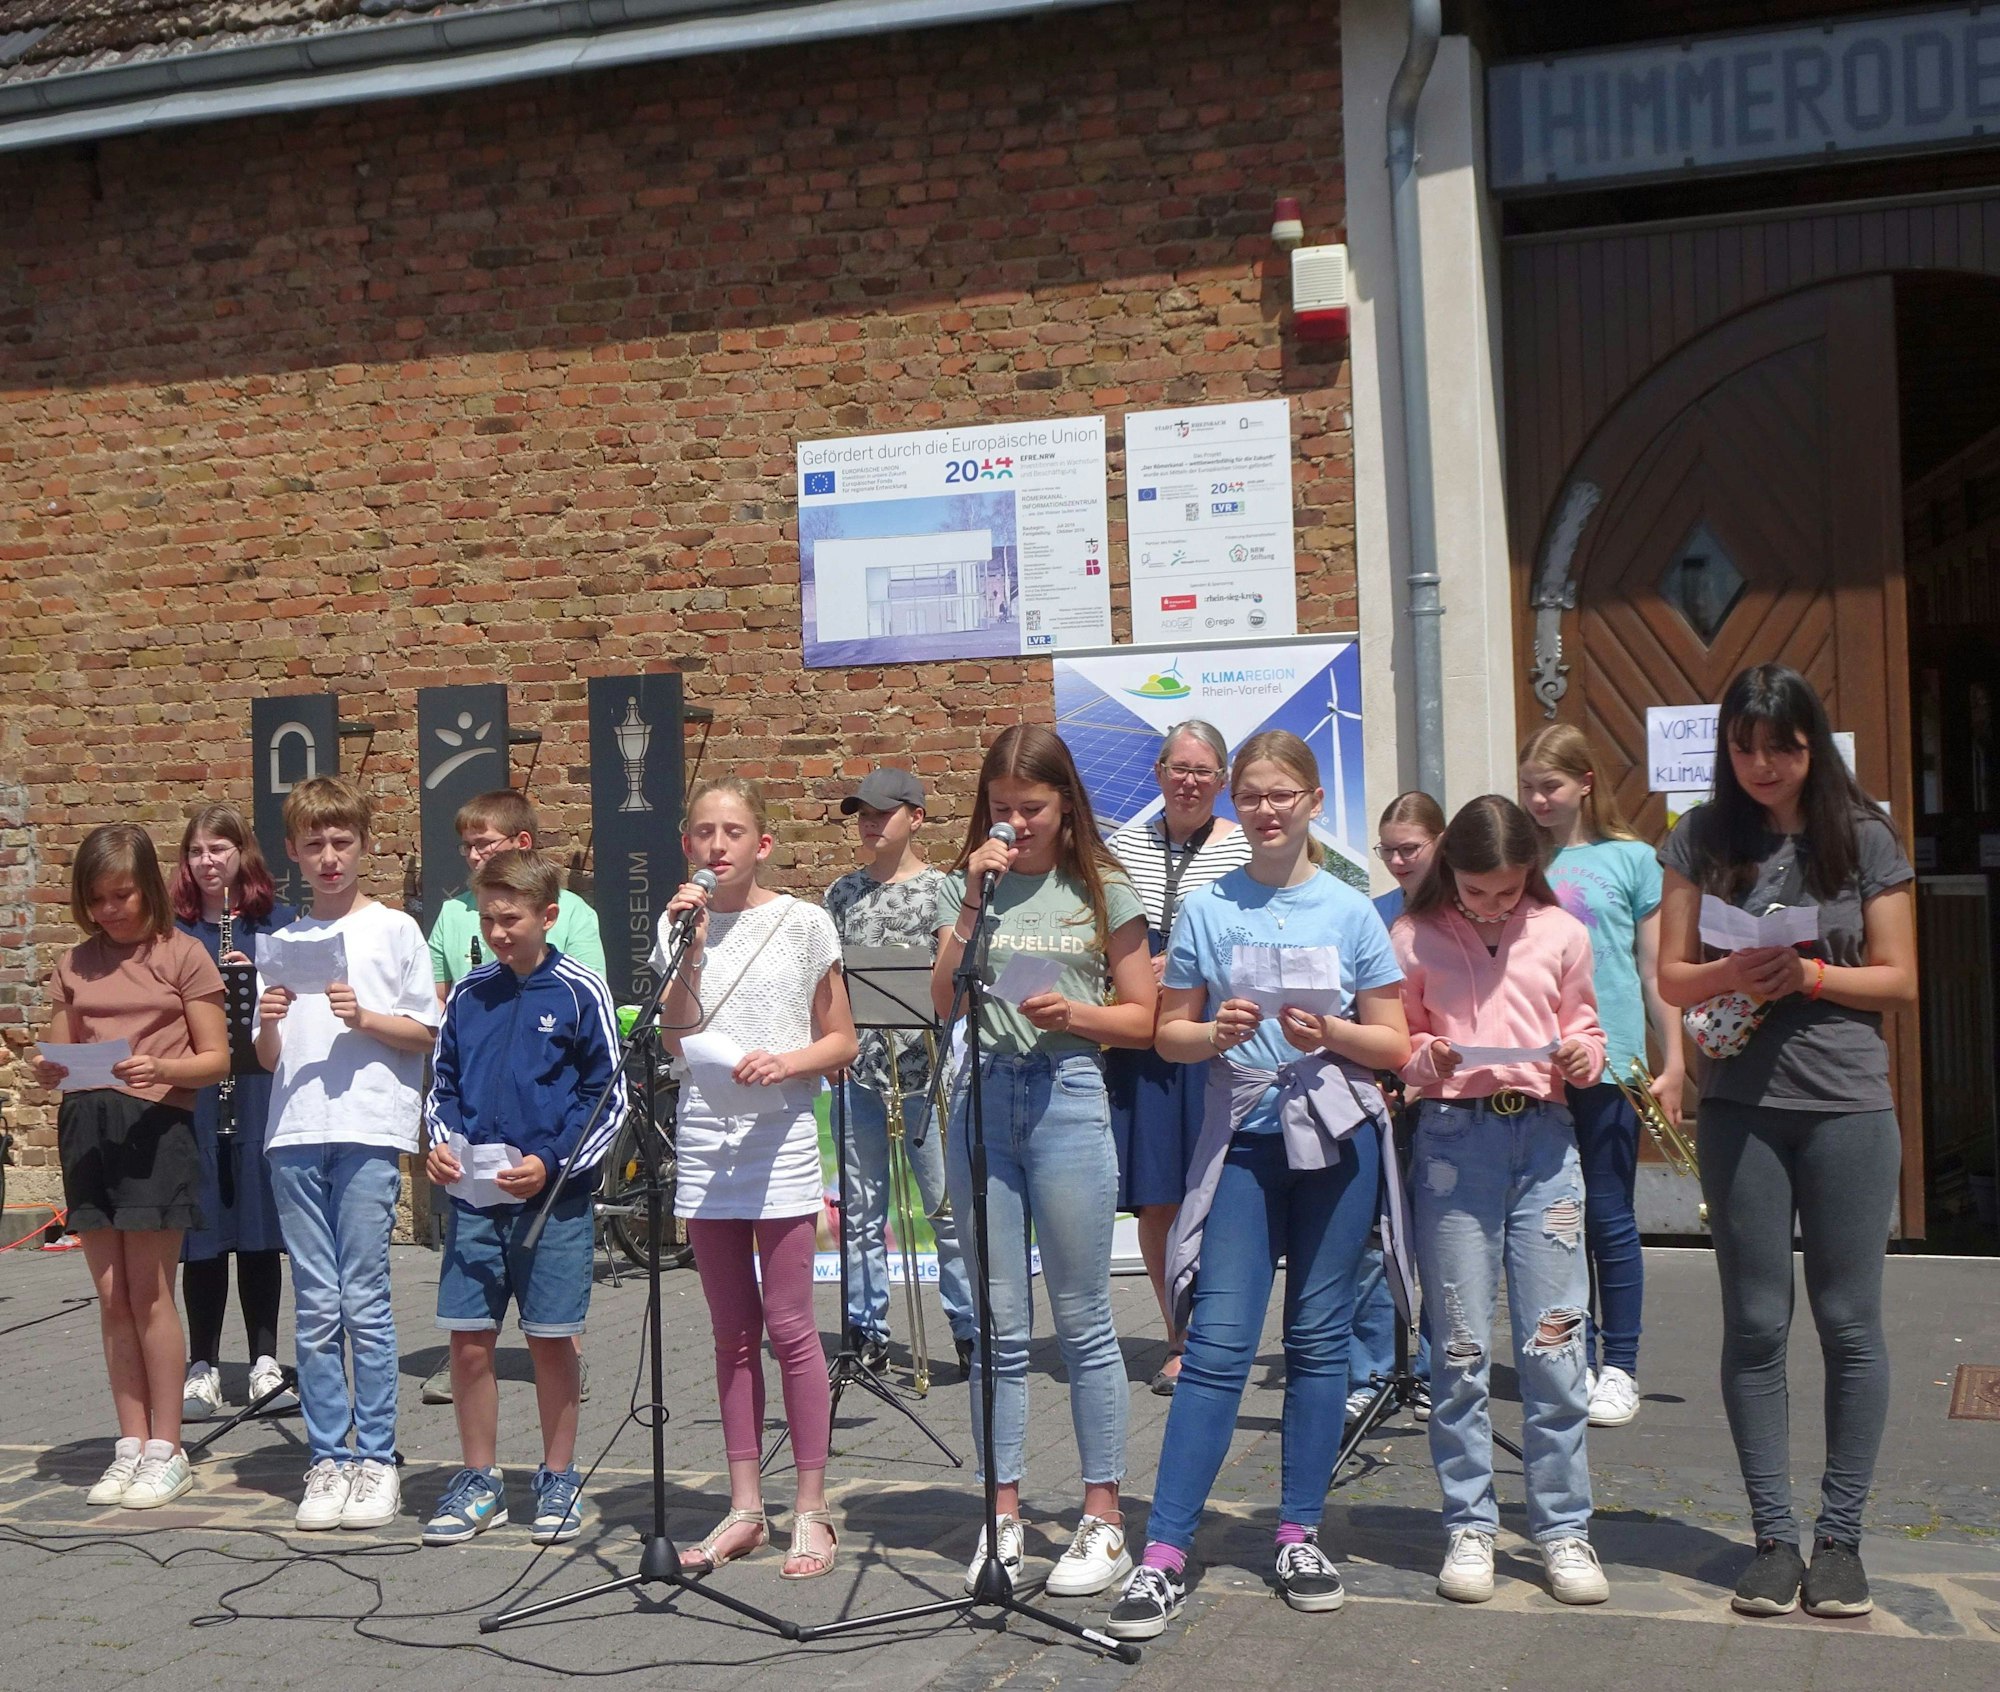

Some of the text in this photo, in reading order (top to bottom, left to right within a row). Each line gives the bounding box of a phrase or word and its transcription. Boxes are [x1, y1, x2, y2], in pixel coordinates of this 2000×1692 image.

[803, 428, 1098, 465] Gefördert durch die Europäische Union
[1022, 494, 1063, 502] RÖMERKANAL
[1022, 499, 1098, 510] INFORMATIONSZENTRUM
[1212, 504, 1232, 512] LVR
[1216, 618, 1234, 627] regio
[1028, 637, 1046, 645] LVR
[1202, 668, 1294, 684] KLIMAREGION
[1202, 682, 1282, 696] Rhein-Voreifel
[628, 852, 652, 1004] SMUSEUM
